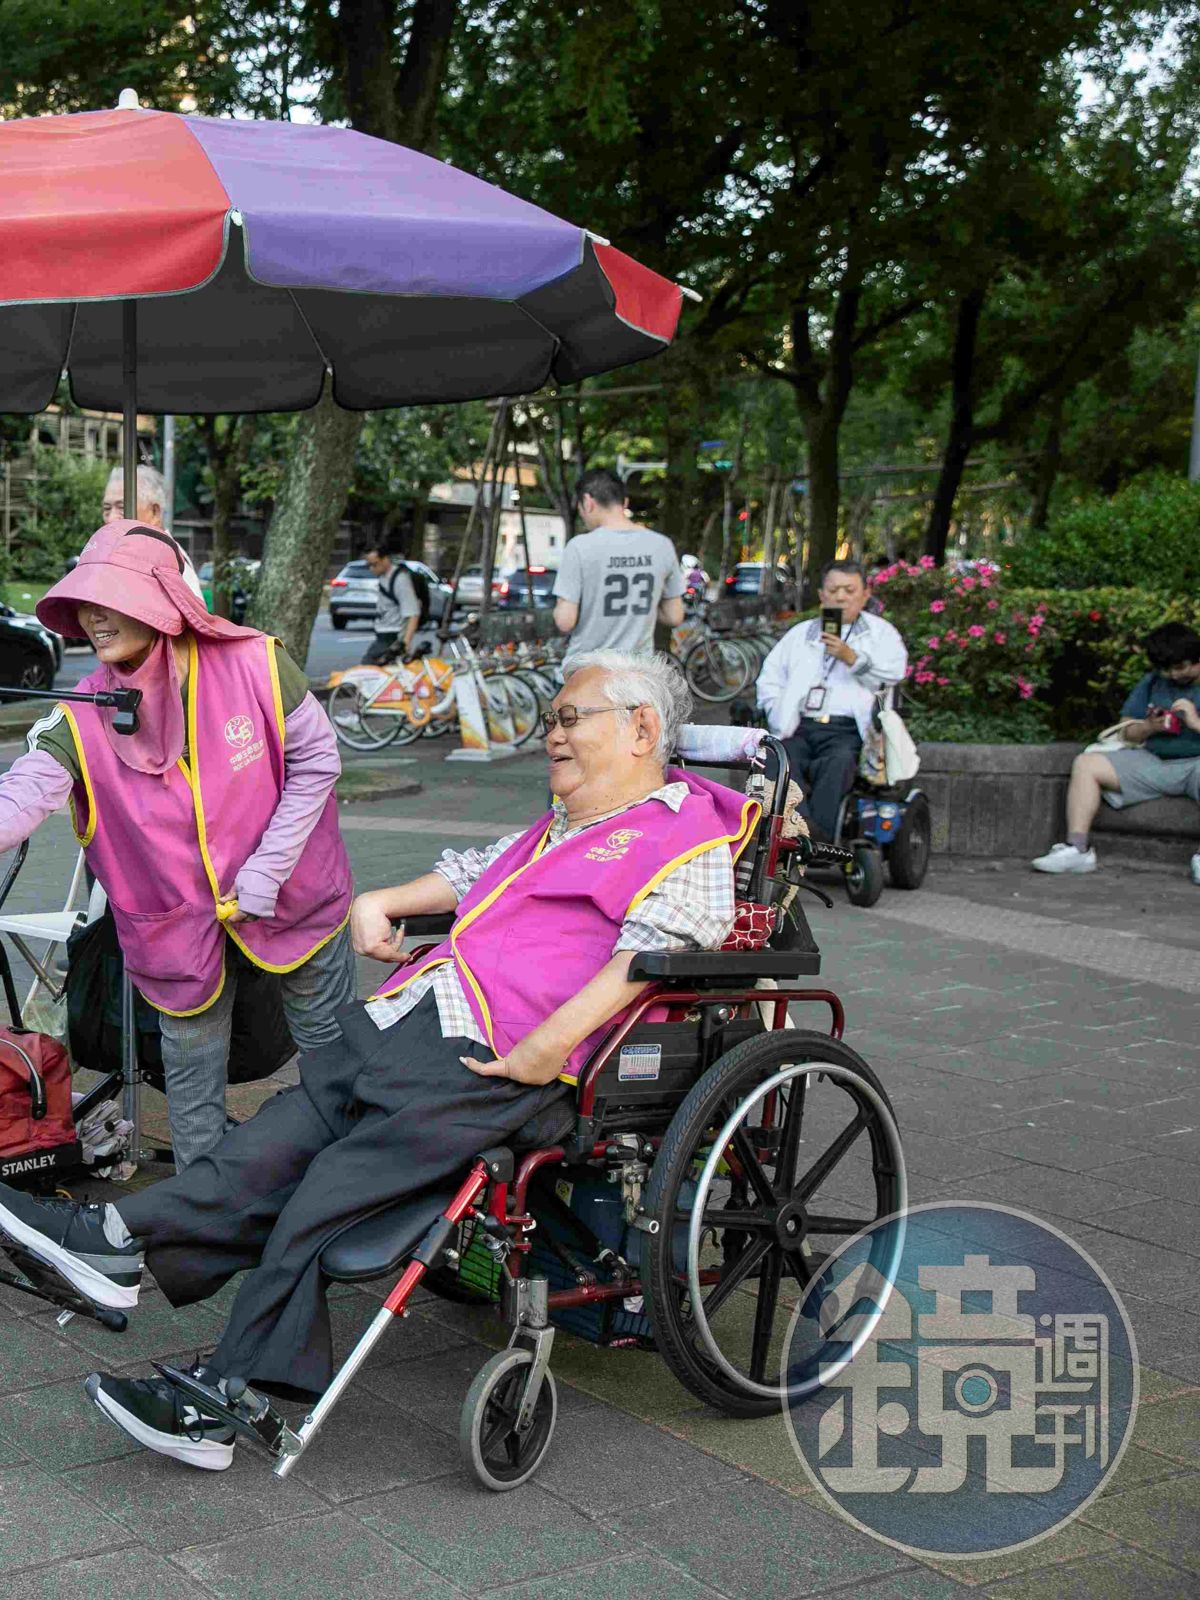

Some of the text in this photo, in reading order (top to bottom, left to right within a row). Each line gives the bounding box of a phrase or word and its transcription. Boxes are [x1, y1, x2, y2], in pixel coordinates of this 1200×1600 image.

[607, 555, 652, 568] JORDAN
[603, 572, 655, 617] 23
[1, 1154, 56, 1176] STANLEY
